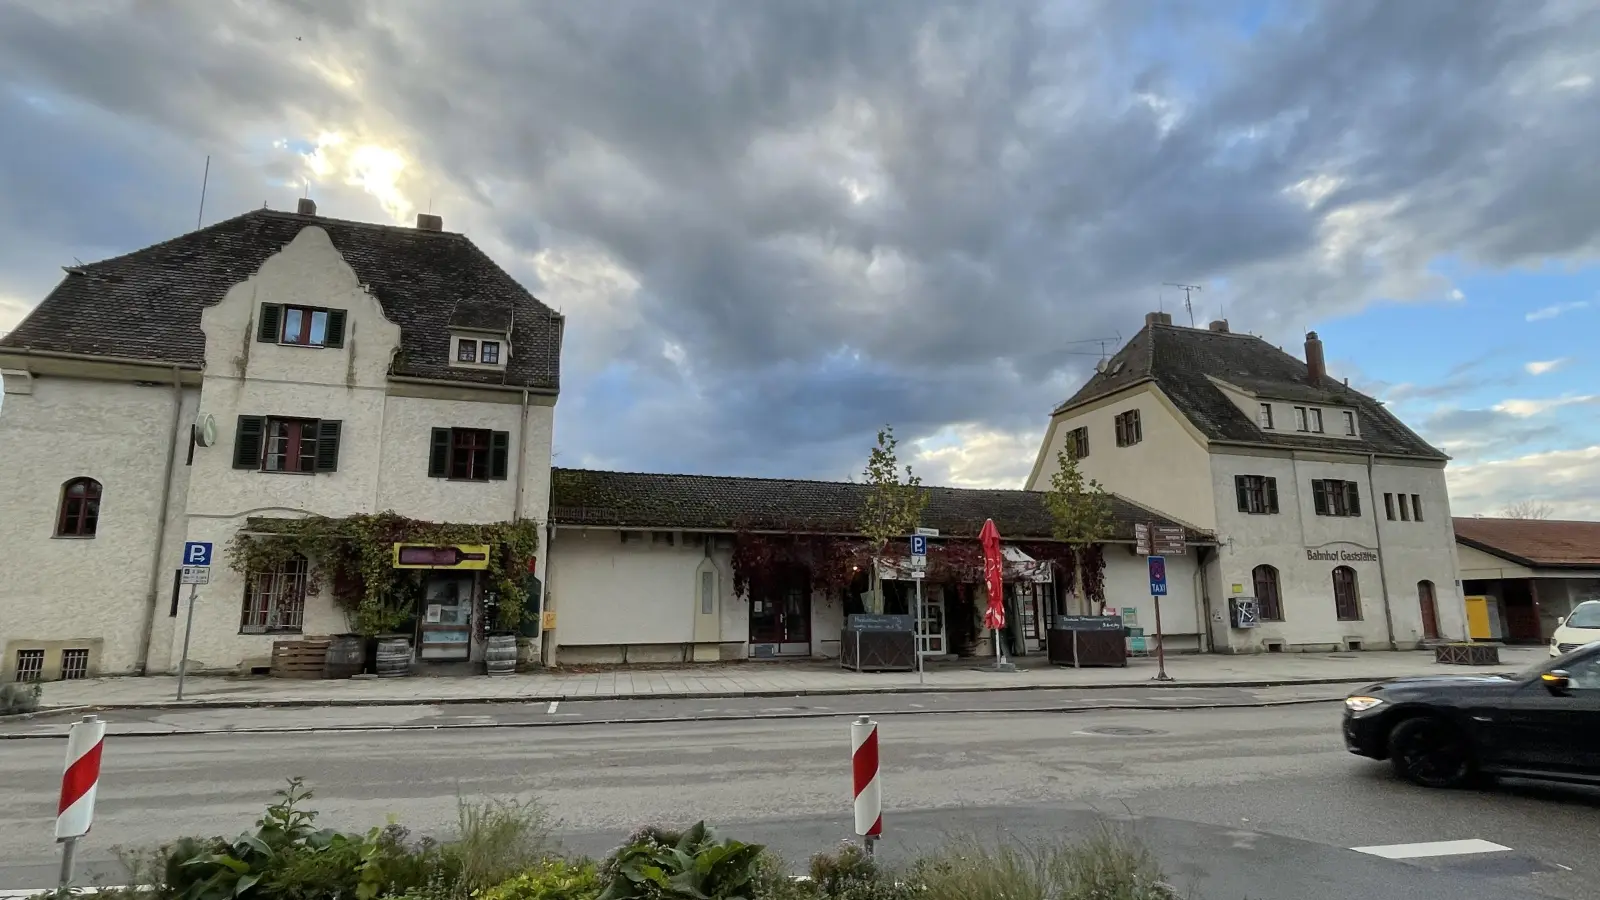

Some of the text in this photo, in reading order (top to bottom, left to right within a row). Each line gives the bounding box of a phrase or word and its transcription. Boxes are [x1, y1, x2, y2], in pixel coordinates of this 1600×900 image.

[914, 537, 923, 553] P
[189, 544, 206, 562] P
[1306, 549, 1339, 561] Bahnhof
[1151, 583, 1166, 593] TAXI
